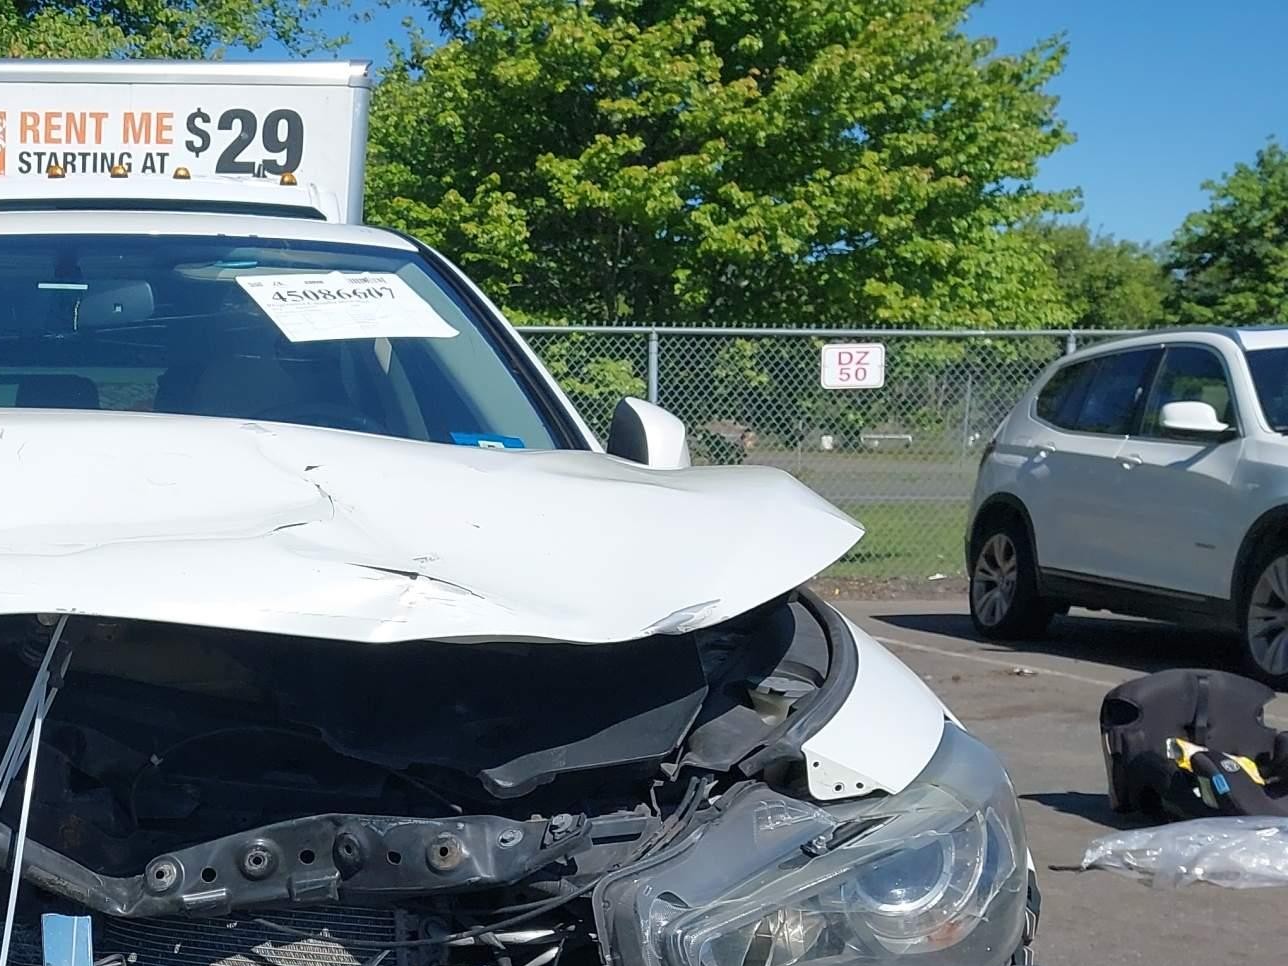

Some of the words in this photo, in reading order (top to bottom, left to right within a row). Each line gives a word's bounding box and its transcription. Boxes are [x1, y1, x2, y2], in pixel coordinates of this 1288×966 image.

[20, 111, 109, 145] RENT
[122, 112, 174, 145] ME
[185, 107, 304, 175] $29
[18, 151, 133, 174] STARTING
[141, 152, 170, 174] AT
[272, 286, 395, 302] 45086607
[838, 351, 870, 365] DZ
[839, 367, 867, 382] 50
